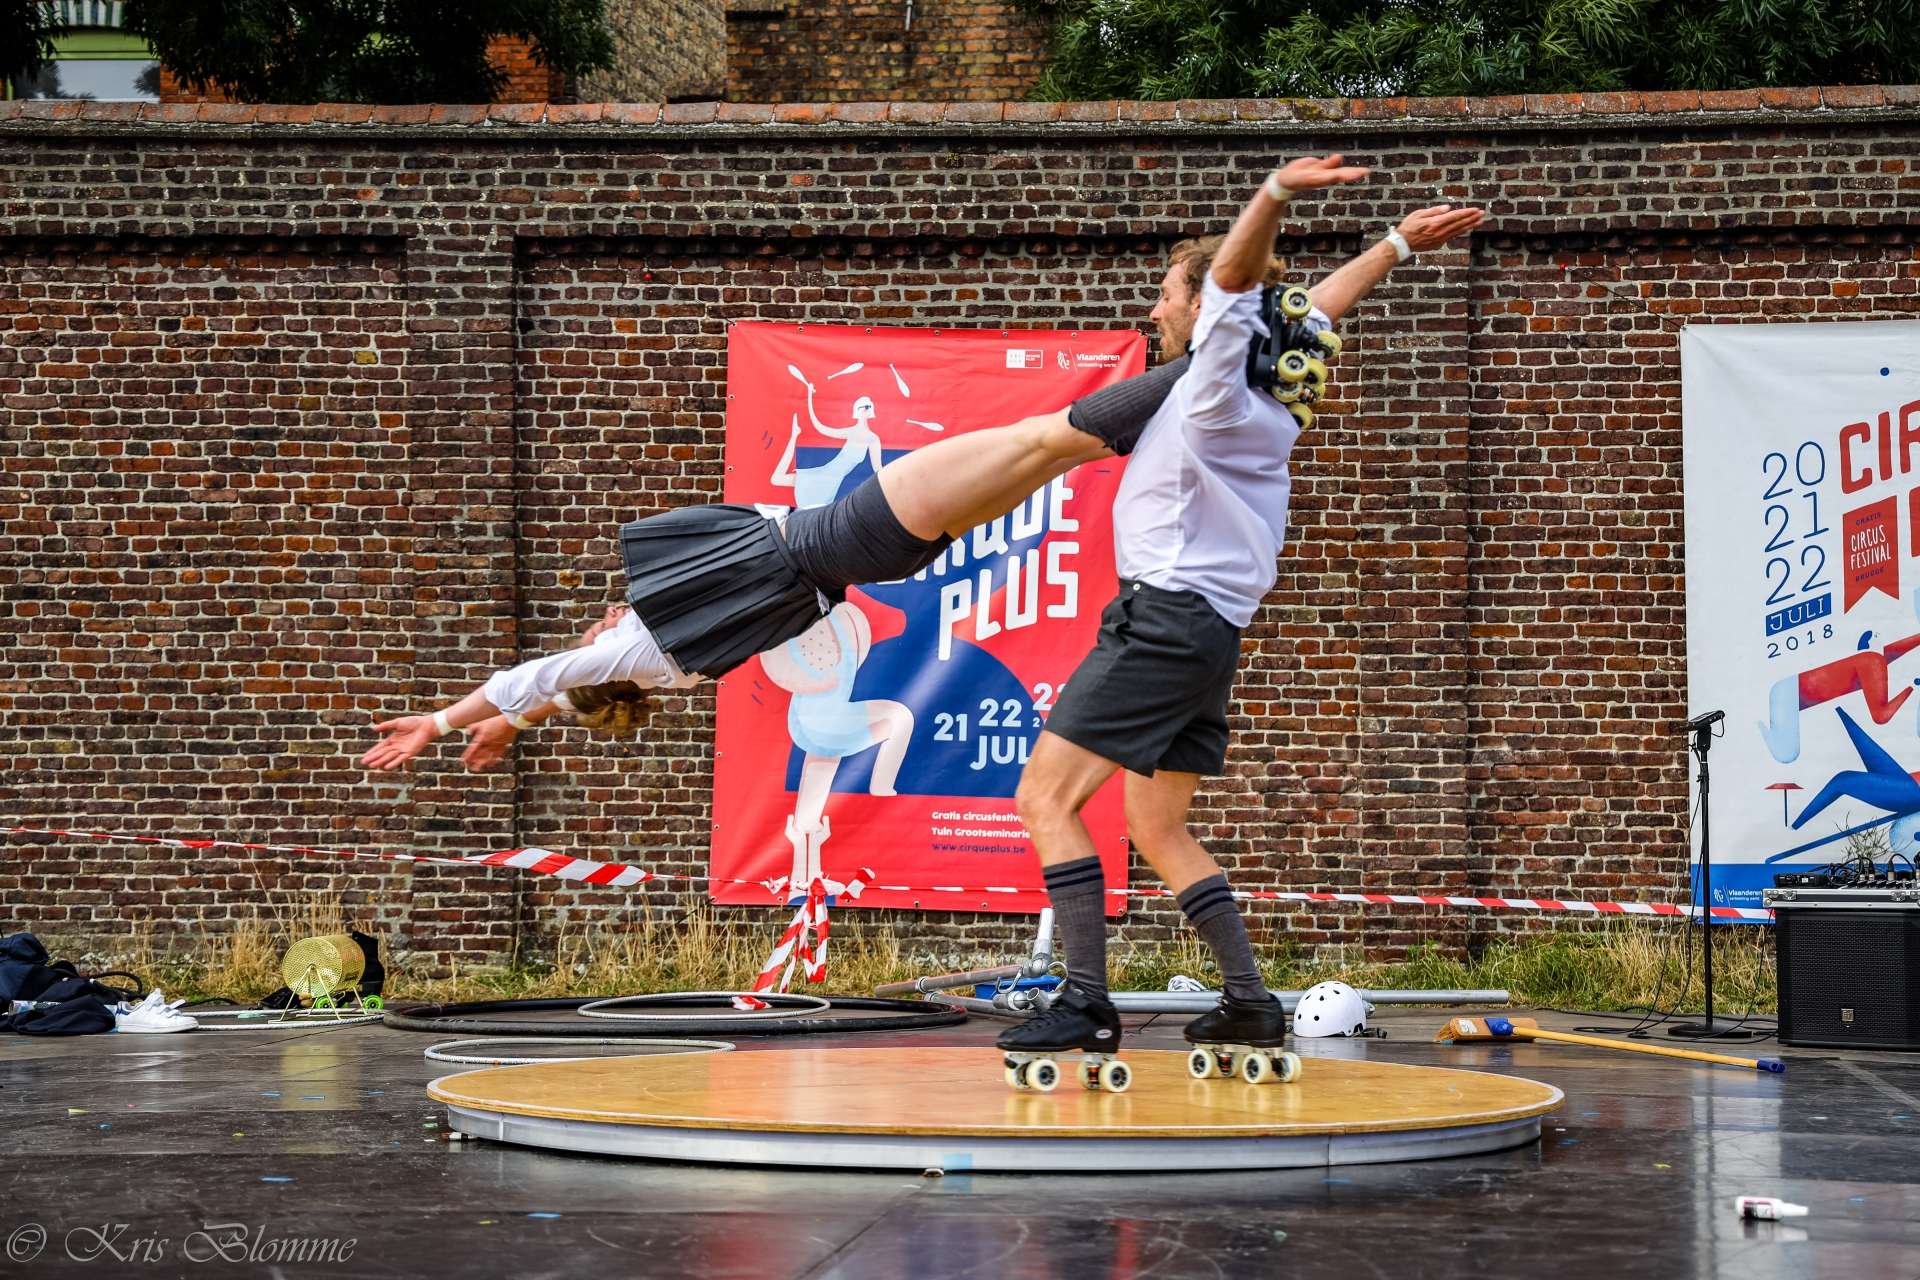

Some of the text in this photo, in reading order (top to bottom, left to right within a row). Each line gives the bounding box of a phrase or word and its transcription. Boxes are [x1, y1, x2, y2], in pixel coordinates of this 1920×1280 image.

[1076, 352, 1120, 362] Vlaanderen
[1763, 441, 1826, 500] 20
[1764, 491, 1830, 552] 21
[1851, 524, 1886, 552] CIRCUS
[1850, 542, 1892, 571] FESTIVAL
[1765, 545, 1832, 606] 22
[938, 541, 1080, 661] PLUS
[1769, 597, 1825, 631] JULI
[1767, 624, 1833, 659] 2018
[933, 682, 1066, 742] 21 22 2
[931, 811, 961, 821] Gratis
[931, 826, 953, 836] Tuin
